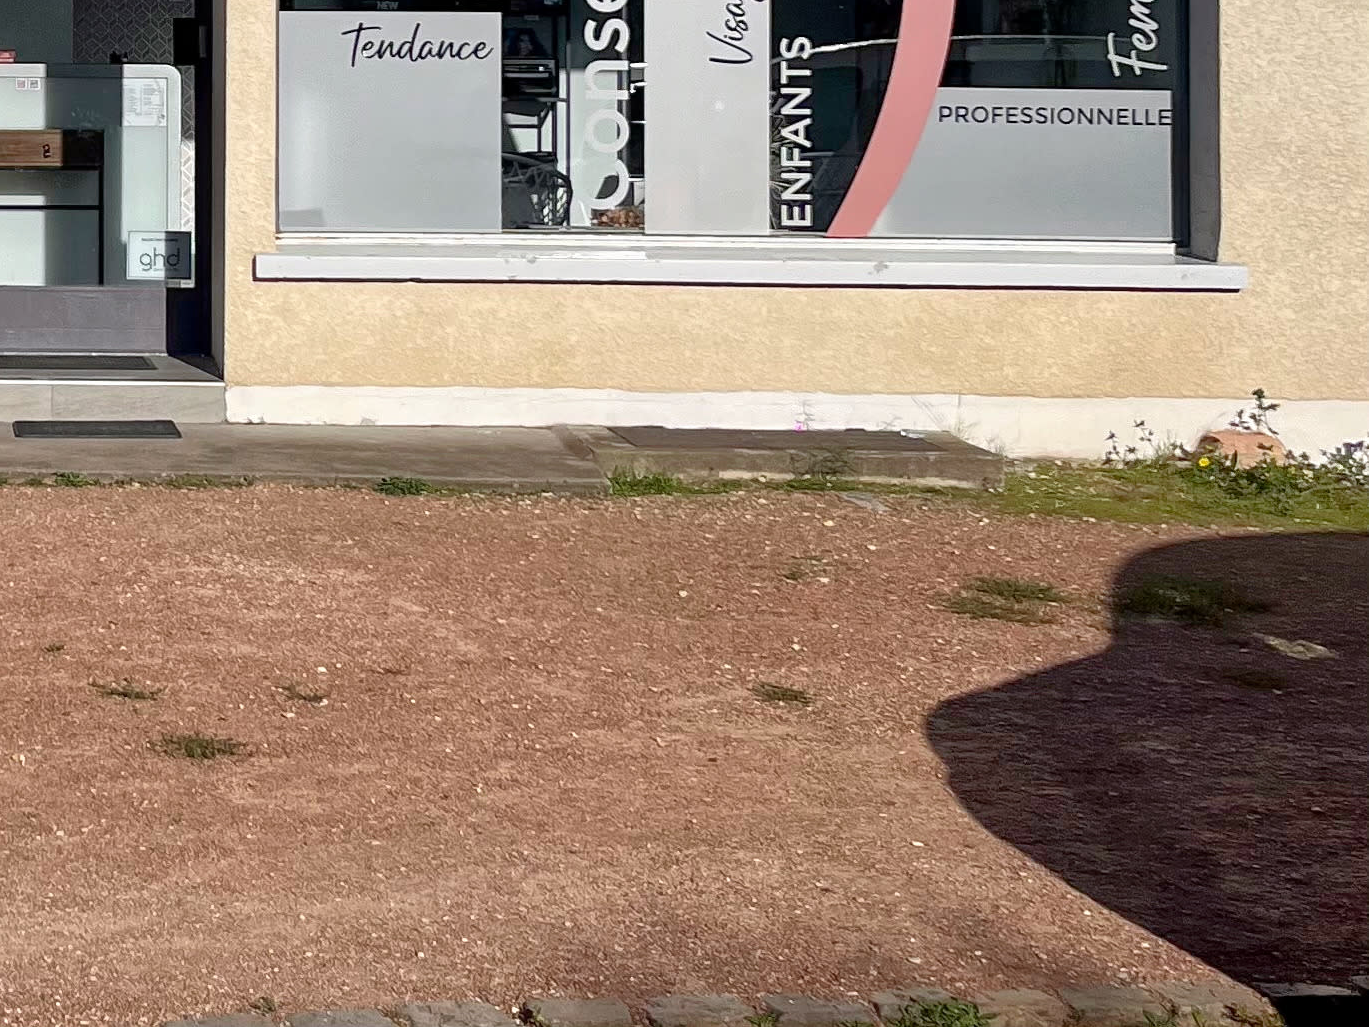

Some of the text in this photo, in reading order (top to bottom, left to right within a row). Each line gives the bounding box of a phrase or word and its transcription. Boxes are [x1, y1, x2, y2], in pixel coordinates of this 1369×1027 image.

[341, 22, 494, 68] Tendance
[781, 35, 814, 228] ENFANTS
[937, 104, 1172, 126] PROFESSIONNELLE
[139, 246, 181, 272] ghd
